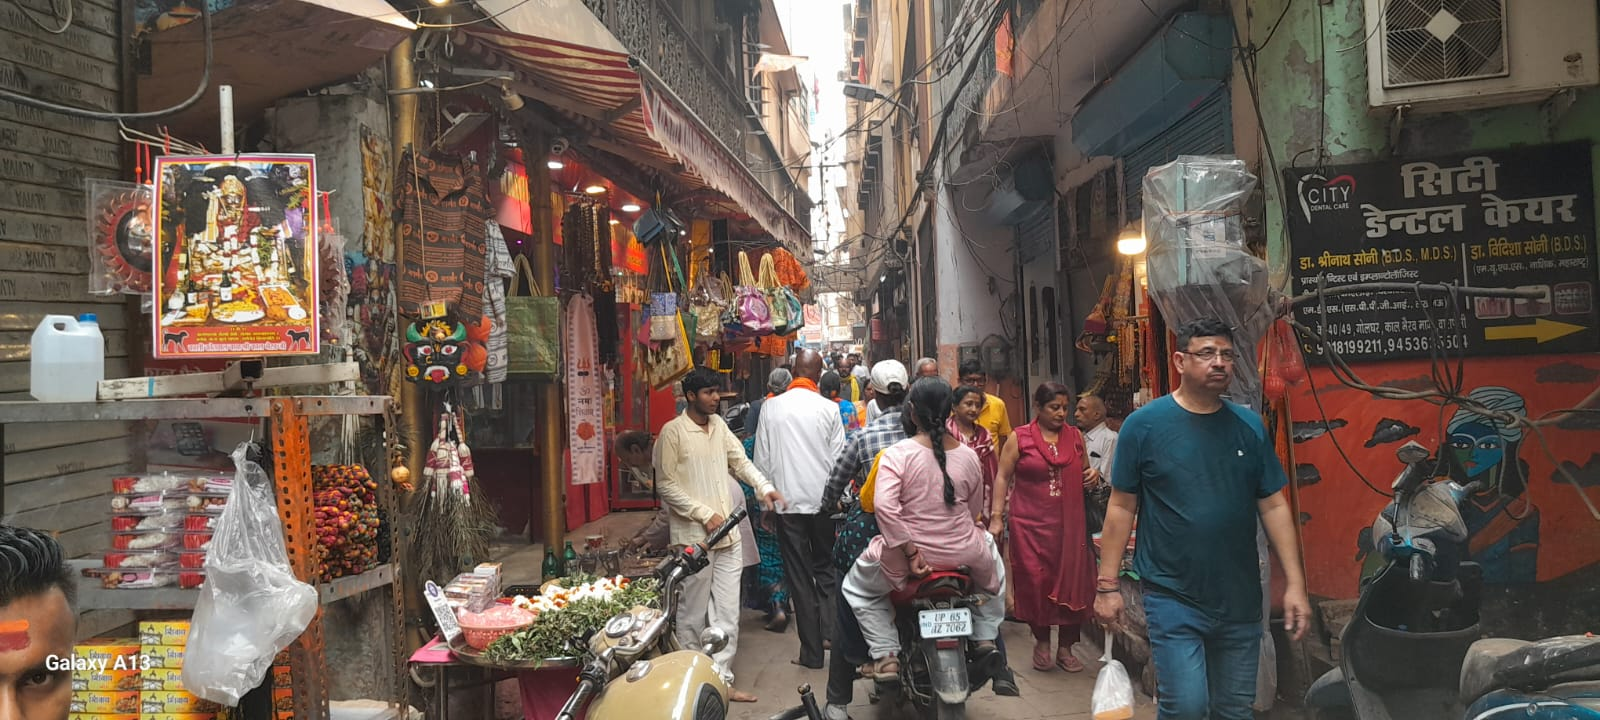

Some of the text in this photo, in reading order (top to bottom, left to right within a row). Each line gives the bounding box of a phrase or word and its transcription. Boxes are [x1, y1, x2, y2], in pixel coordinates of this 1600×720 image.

[1400, 156, 1500, 198] सिटी
[1308, 186, 1350, 204] CITY
[1360, 194, 1578, 238] डेन्टल केयर
[1299, 256, 1315, 270] डा.
[1318, 250, 1351, 267] श्रीनाथ
[1353, 247, 1379, 266] सोनी
[1421, 244, 1457, 262] M.D.S.)
[1470, 234, 1587, 260] डा. विदिशा सोनी (B.D.S.)
[934, 611, 961, 622] UP 65
[946, 622, 967, 633] 7062
